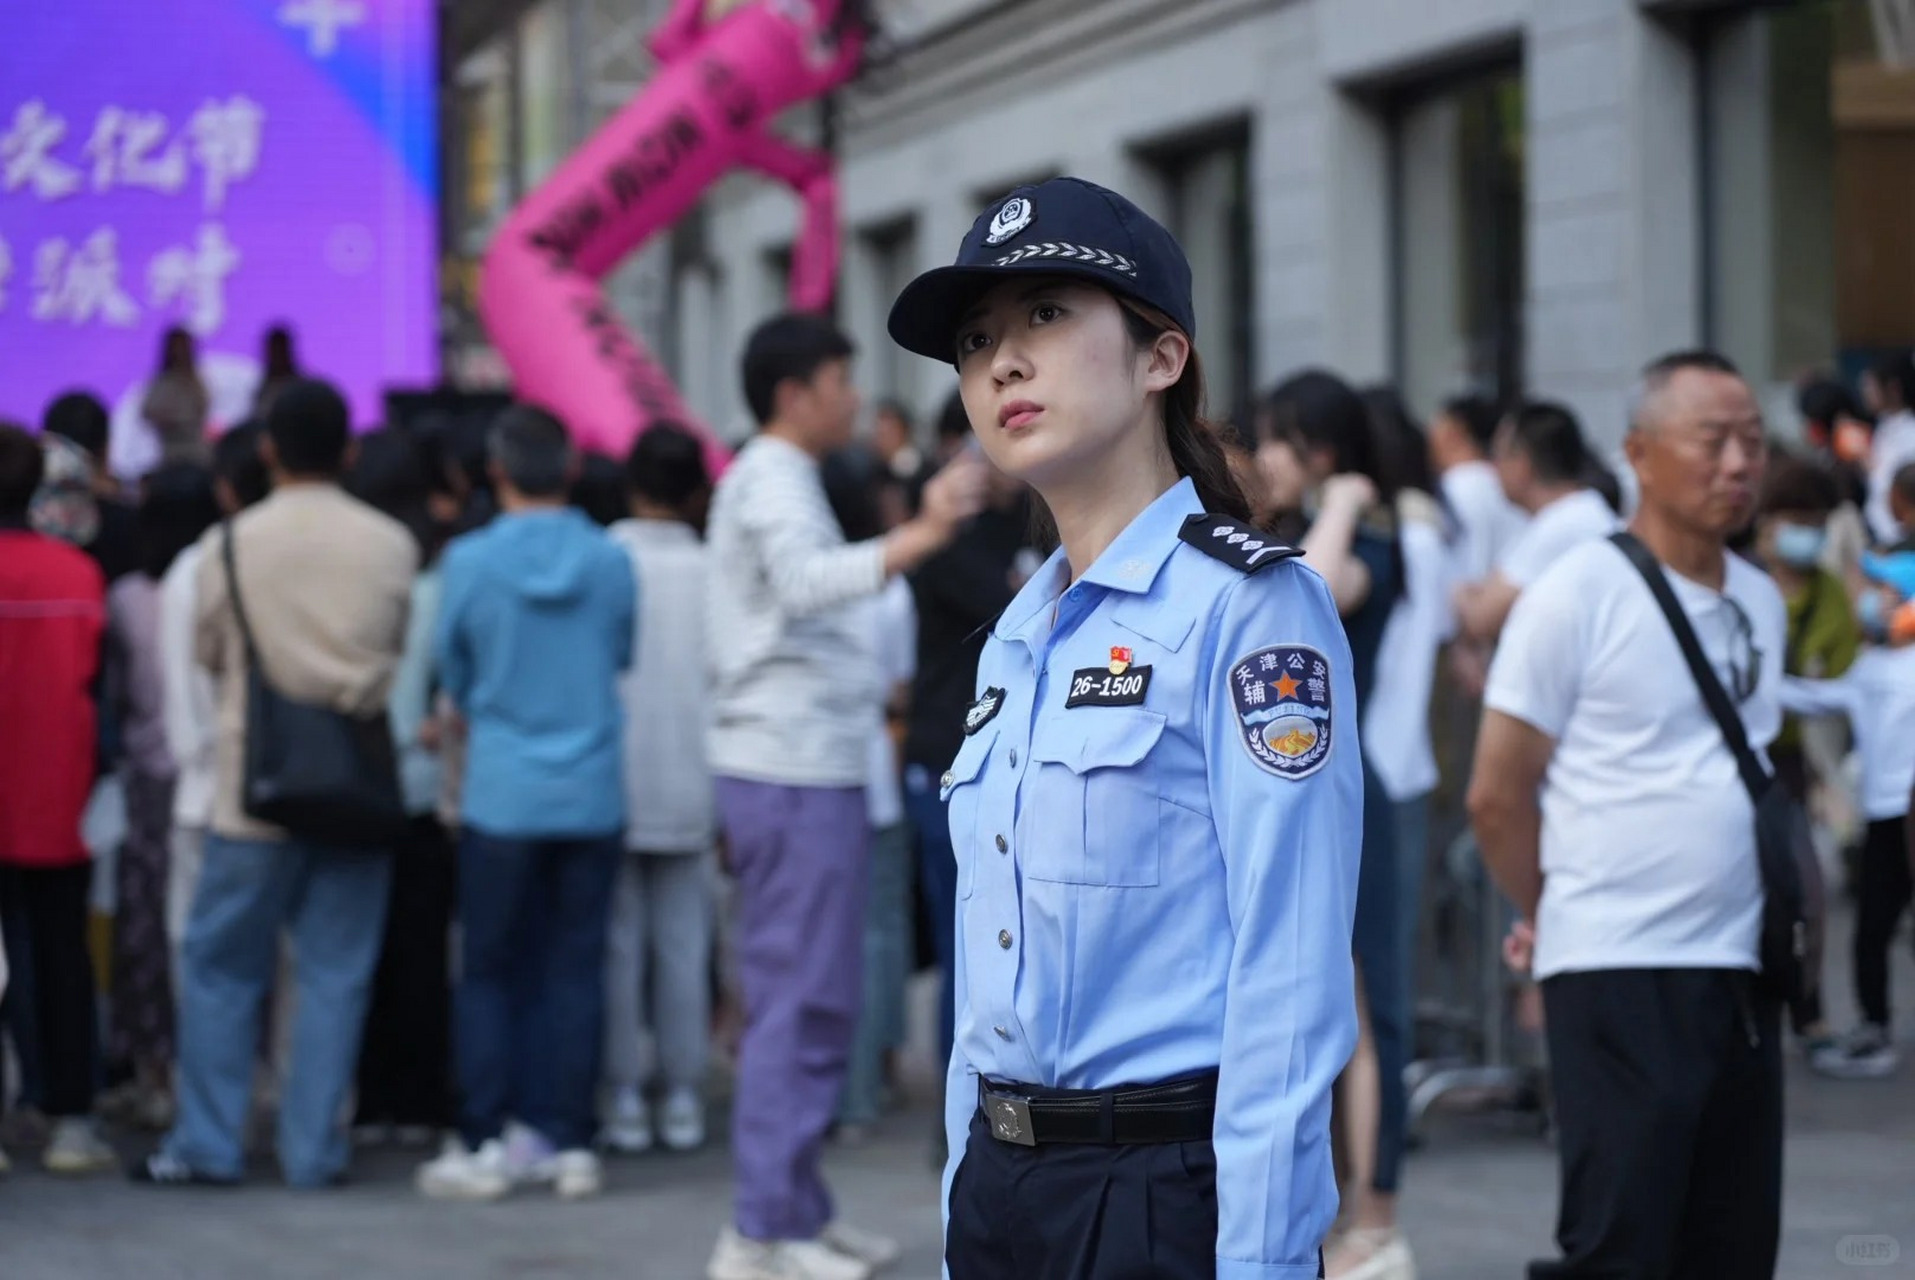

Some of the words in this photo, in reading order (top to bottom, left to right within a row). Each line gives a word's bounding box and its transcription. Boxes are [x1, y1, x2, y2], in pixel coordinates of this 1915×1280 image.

[0, 94, 264, 214] 文化节
[0, 222, 241, 337] 派对
[1236, 653, 1326, 685] 天津公安
[1070, 674, 1143, 698] 26-1500
[1243, 678, 1326, 705] 辅警
